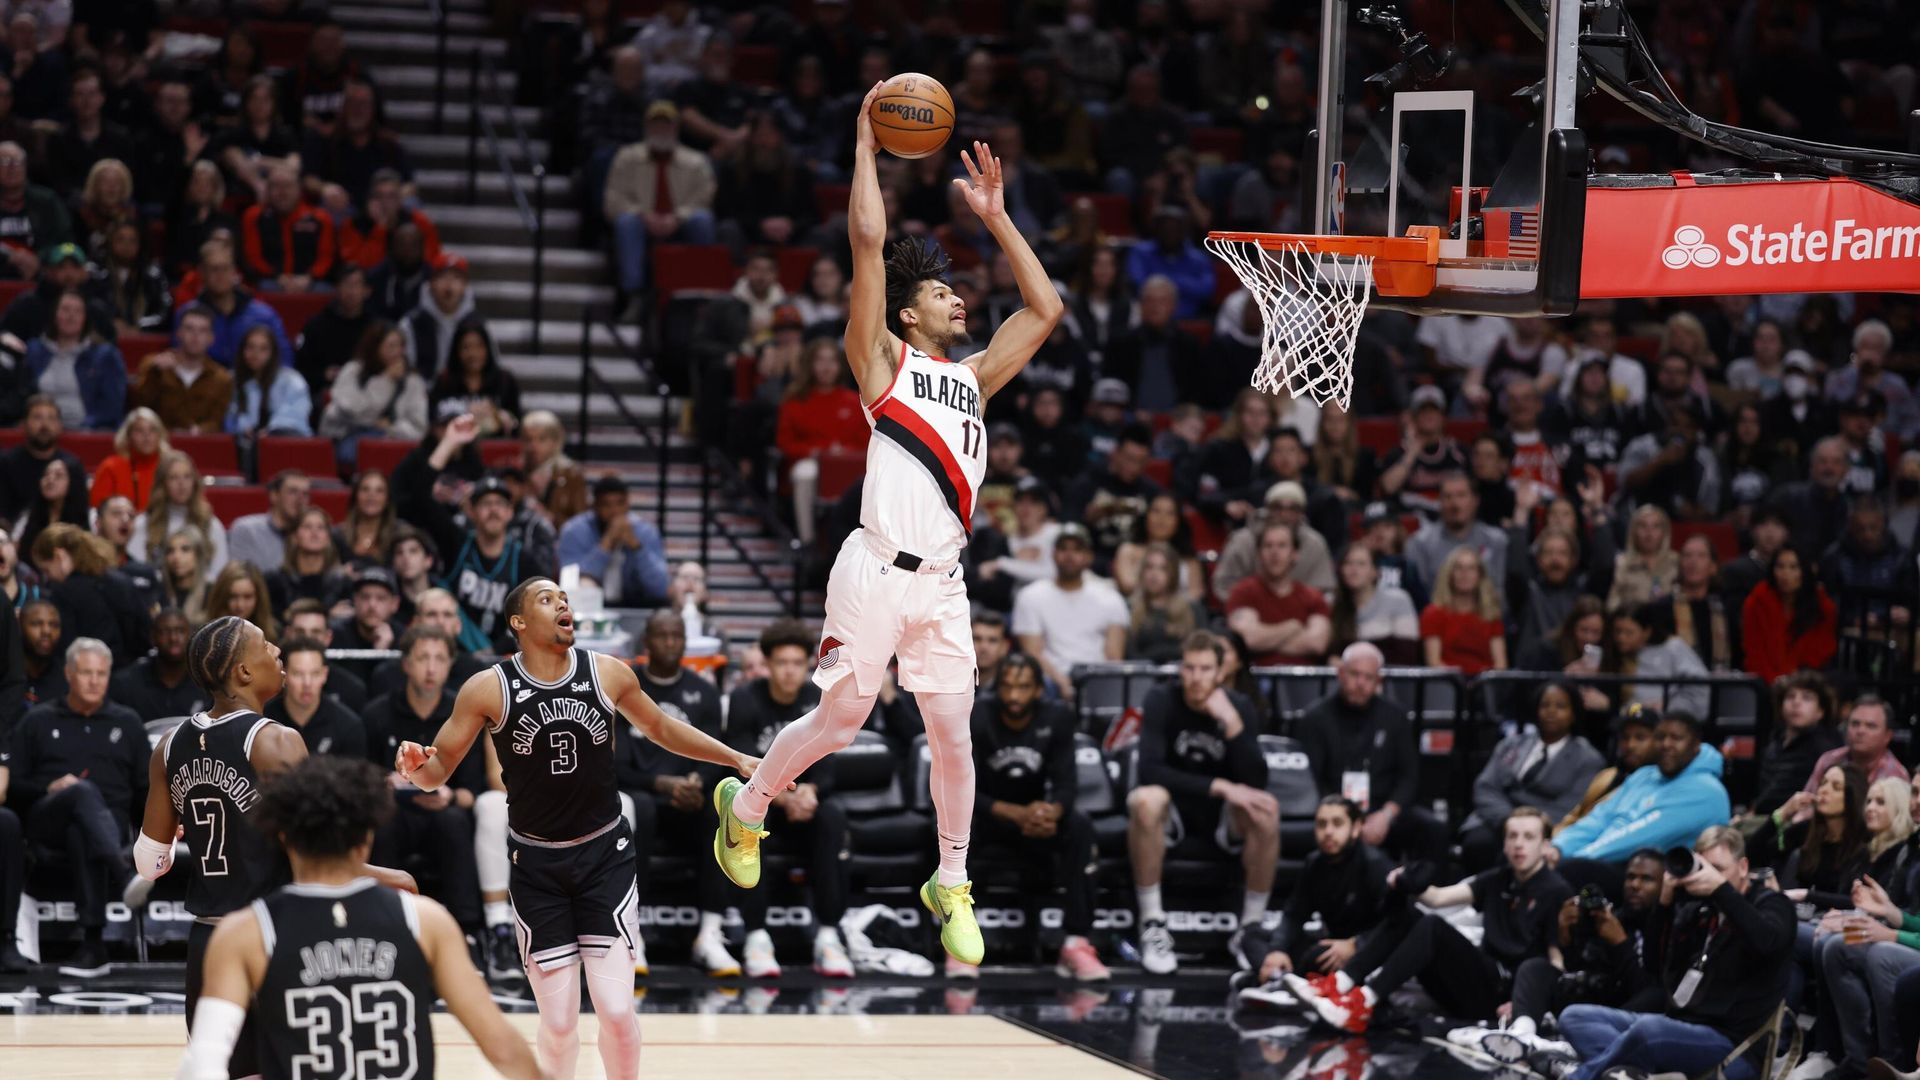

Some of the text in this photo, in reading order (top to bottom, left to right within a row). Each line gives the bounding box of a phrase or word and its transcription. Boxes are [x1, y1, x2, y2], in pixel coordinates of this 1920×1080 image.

[880, 102, 934, 124] Wilson
[962, 419, 981, 460] 17
[512, 679, 521, 689] 6
[512, 713, 541, 755] SAN
[538, 698, 608, 745] ANTONIO
[550, 731, 578, 775] 3
[191, 798, 228, 876] 7
[300, 937, 398, 986] JONES
[284, 980, 419, 1080] 33
